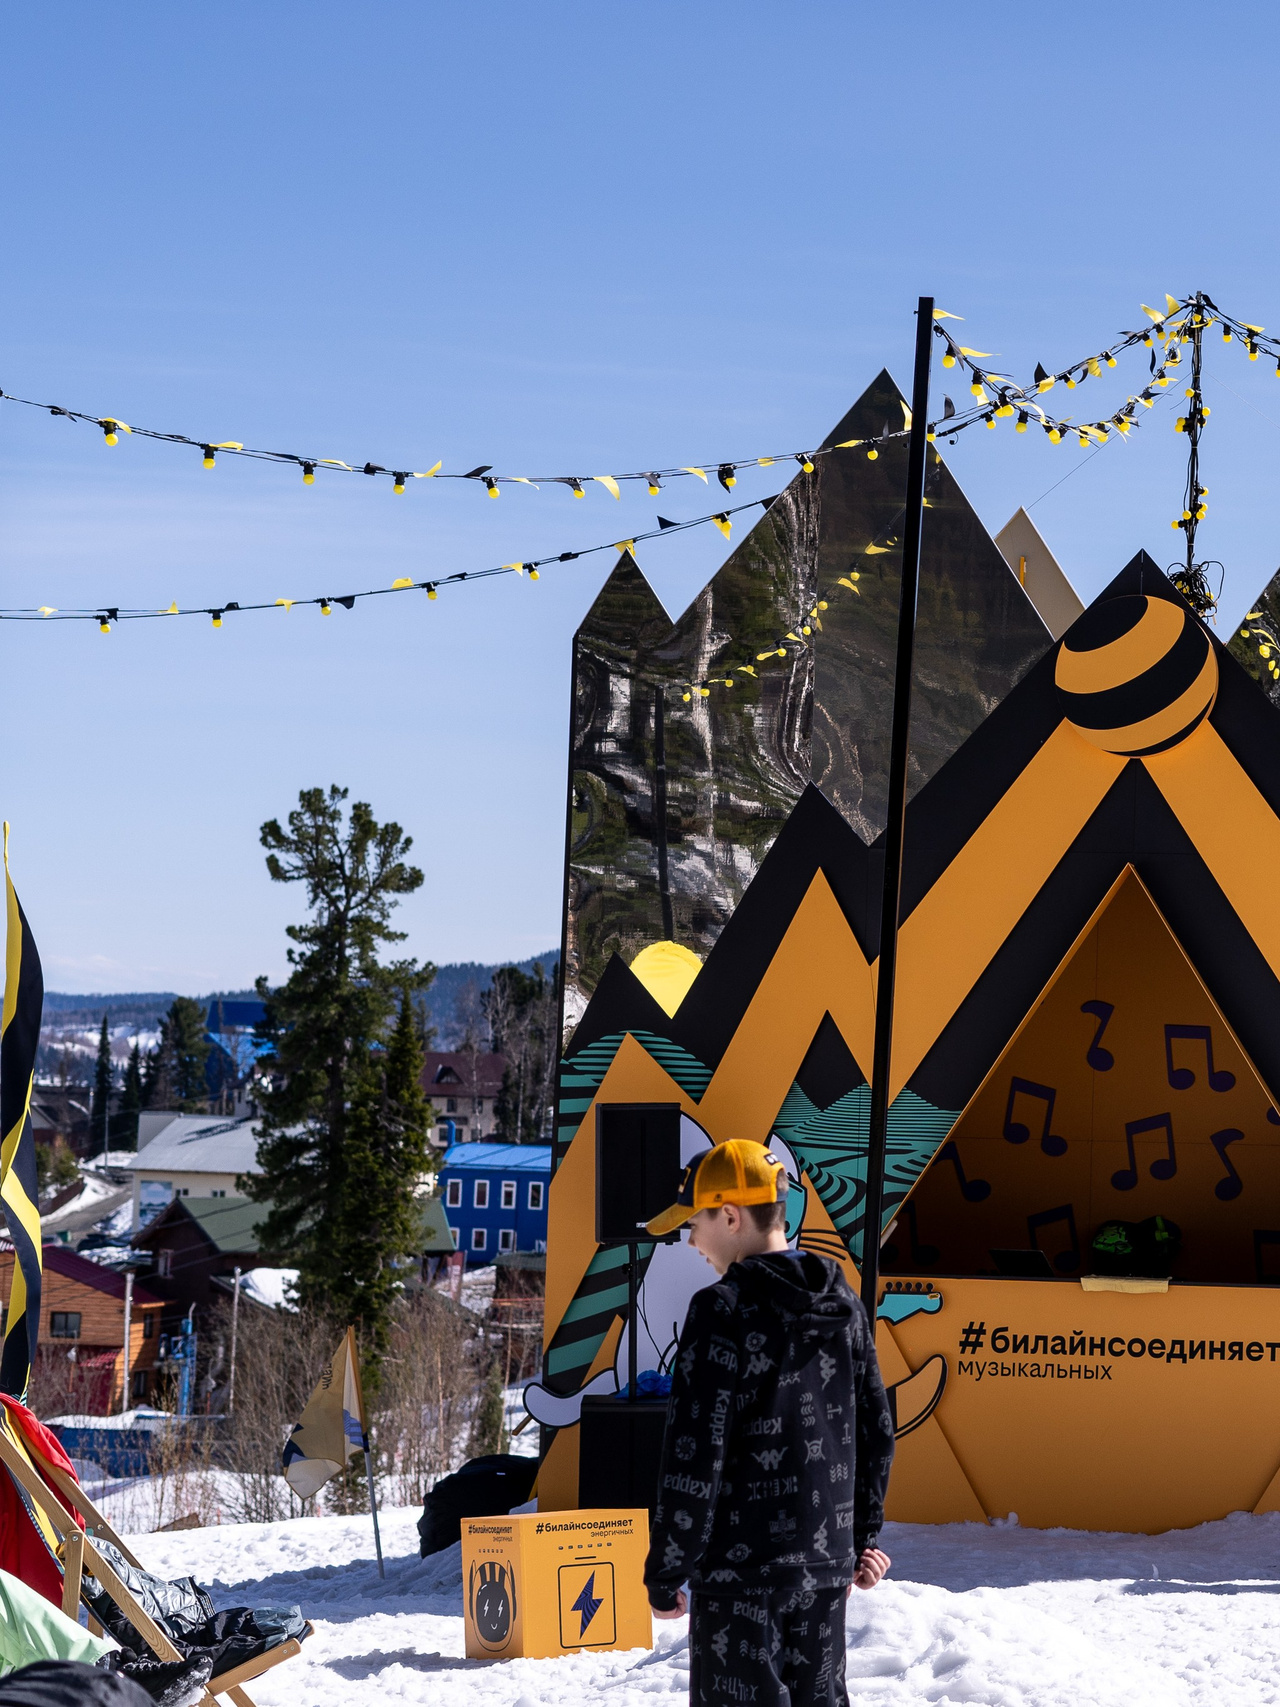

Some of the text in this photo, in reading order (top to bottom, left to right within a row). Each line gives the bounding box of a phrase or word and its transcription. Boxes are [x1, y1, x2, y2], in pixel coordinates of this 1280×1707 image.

[957, 1360, 1113, 1382] музыкальных
[709, 1387, 731, 1446] Kappa
[663, 1472, 712, 1500] Kappa
[535, 1518, 634, 1535] #билайнсоединяет
[590, 1528, 634, 1539] энергичных
